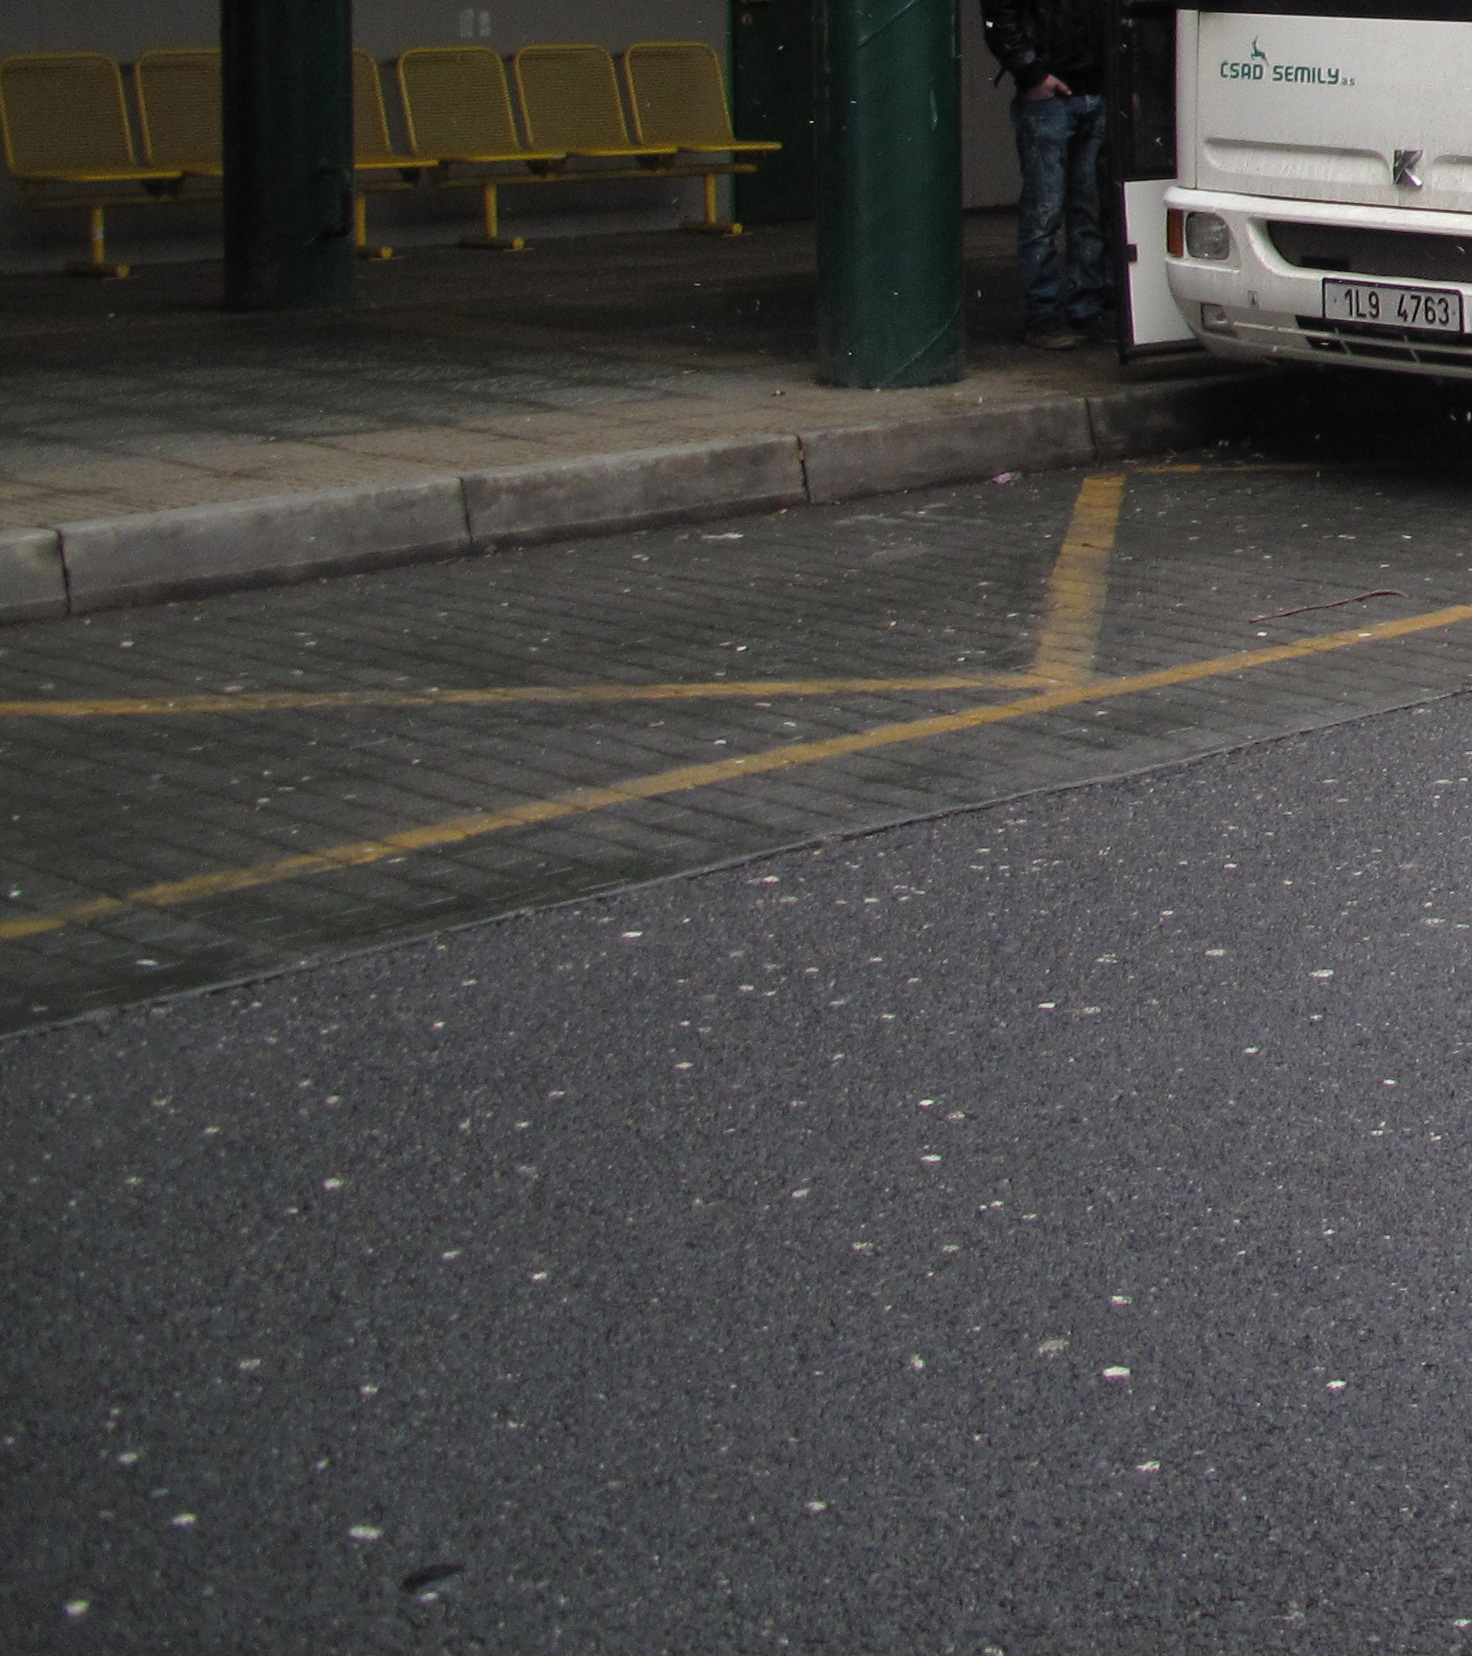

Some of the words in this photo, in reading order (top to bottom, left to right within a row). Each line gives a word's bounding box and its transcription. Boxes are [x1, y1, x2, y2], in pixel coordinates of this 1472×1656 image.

[1272, 65, 1340, 84] SEMILY
[1344, 288, 1380, 319] 1L9
[1397, 294, 1450, 326] 4763
